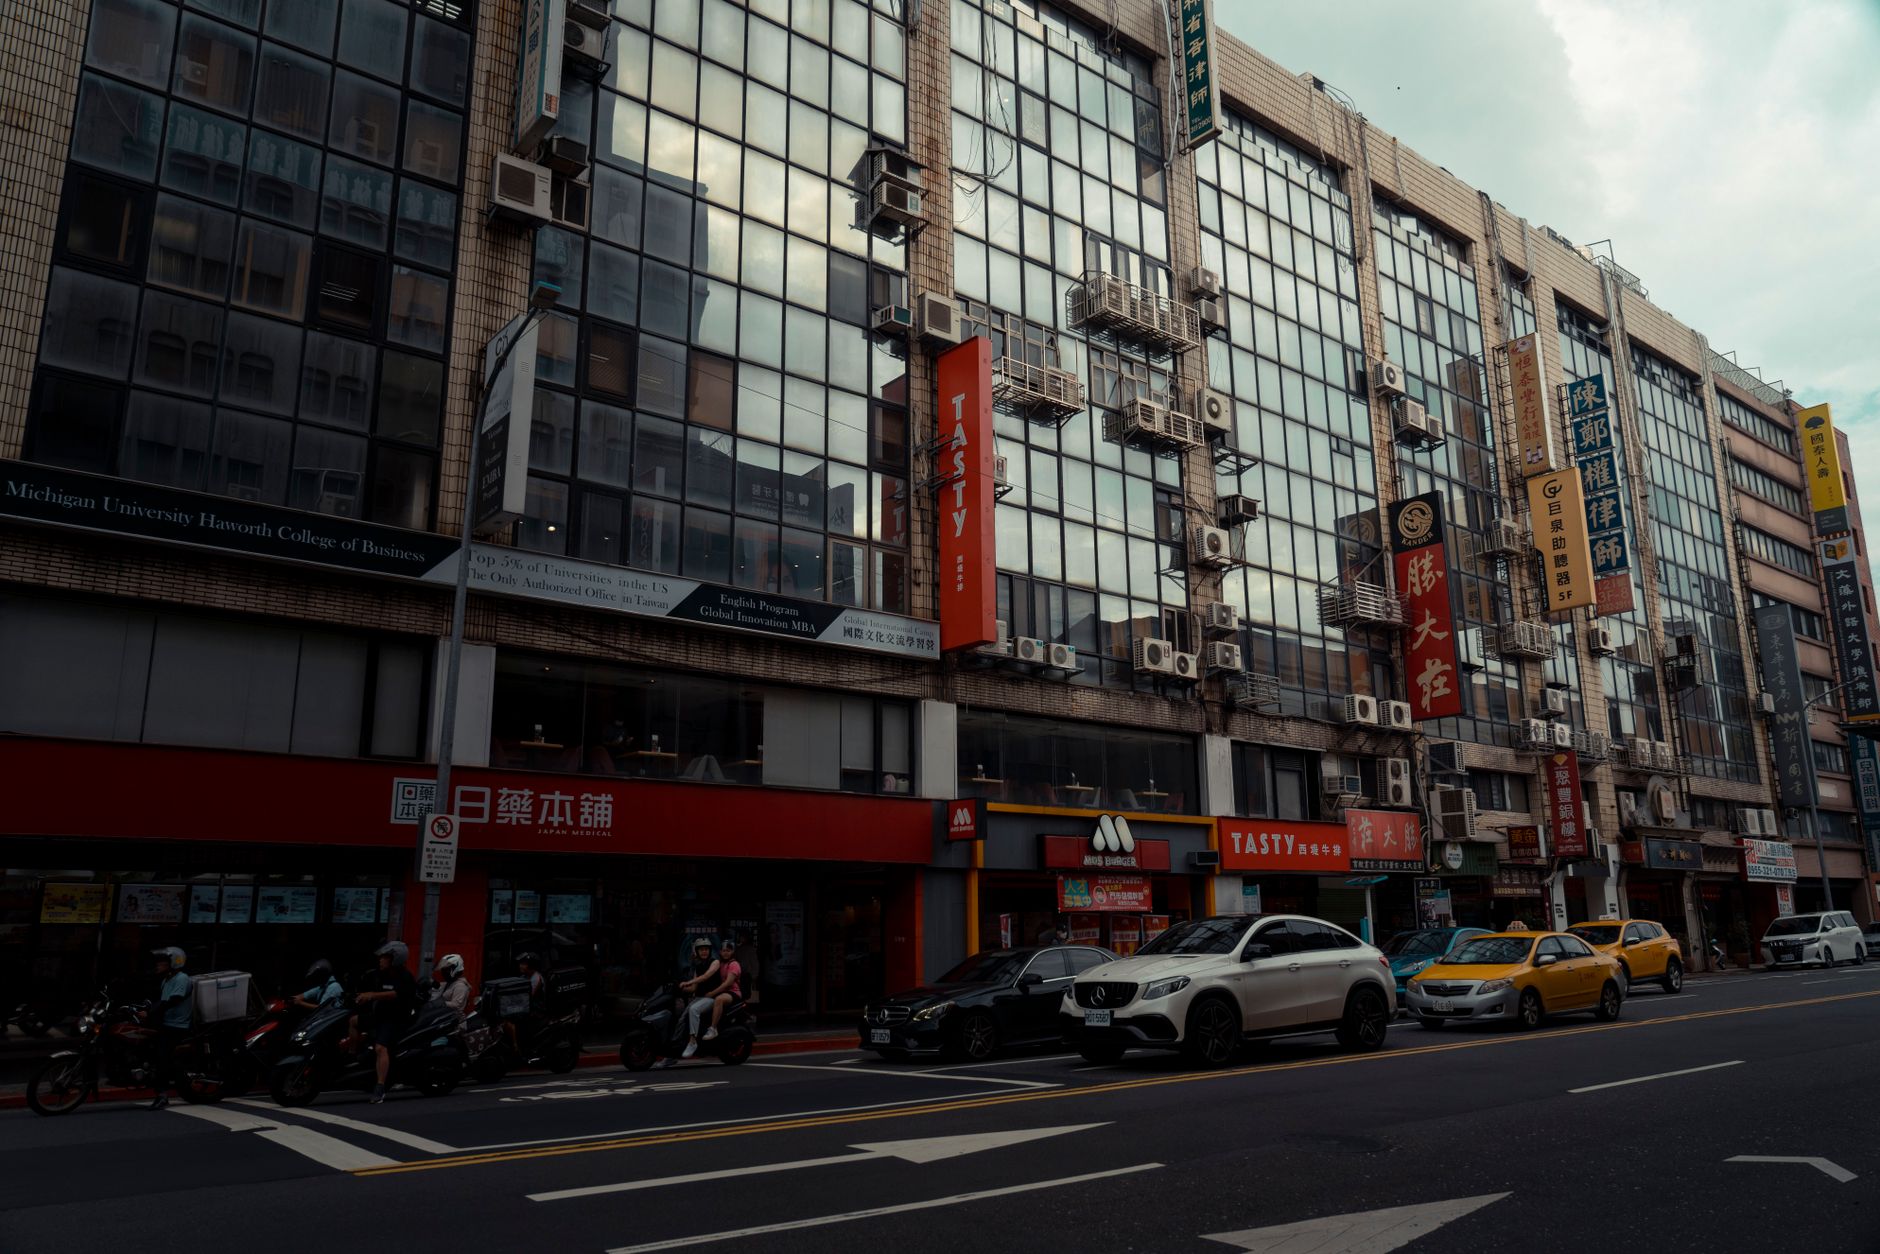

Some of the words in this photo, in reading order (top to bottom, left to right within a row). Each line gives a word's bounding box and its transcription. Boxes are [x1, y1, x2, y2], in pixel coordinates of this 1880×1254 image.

[951, 392, 968, 538] TASTY
[5, 479, 96, 510] Michigan
[103, 496, 194, 529] University
[198, 512, 273, 538] Haworth
[278, 526, 337, 551] College
[340, 537, 362, 552] of
[362, 539, 426, 564] Business
[1400, 532, 1434, 546] KANDER
[1548, 500, 1570, 587] 巨泉助聽器
[501, 555, 524, 571] 5%
[527, 558, 541, 573] of
[544, 562, 613, 586] Universities
[630, 578, 649, 591] the
[651, 581, 669, 594] US
[489, 569, 518, 591] Only
[522, 575, 583, 597] Authorized
[585, 586, 617, 603] Office
[621, 592, 632, 604] in
[634, 593, 670, 610] Taiwan
[1558, 590, 1573, 602] 5F
[720, 592, 757, 613] English
[759, 599, 800, 618] Program
[700, 604, 734, 622] Global
[736, 610, 788, 630] Innovation
[791, 619, 817, 634] MBA
[843, 614, 869, 628] Global
[871, 618, 914, 634] International
[842, 626, 936, 652] 國際文化交流學習營
[538, 828, 568, 836] JAPAN
[572, 829, 612, 838] MEDICAL
[1232, 832, 1295, 855] TASTY
[1083, 855, 1103, 867] MOS
[1104, 856, 1137, 868] BURGER
